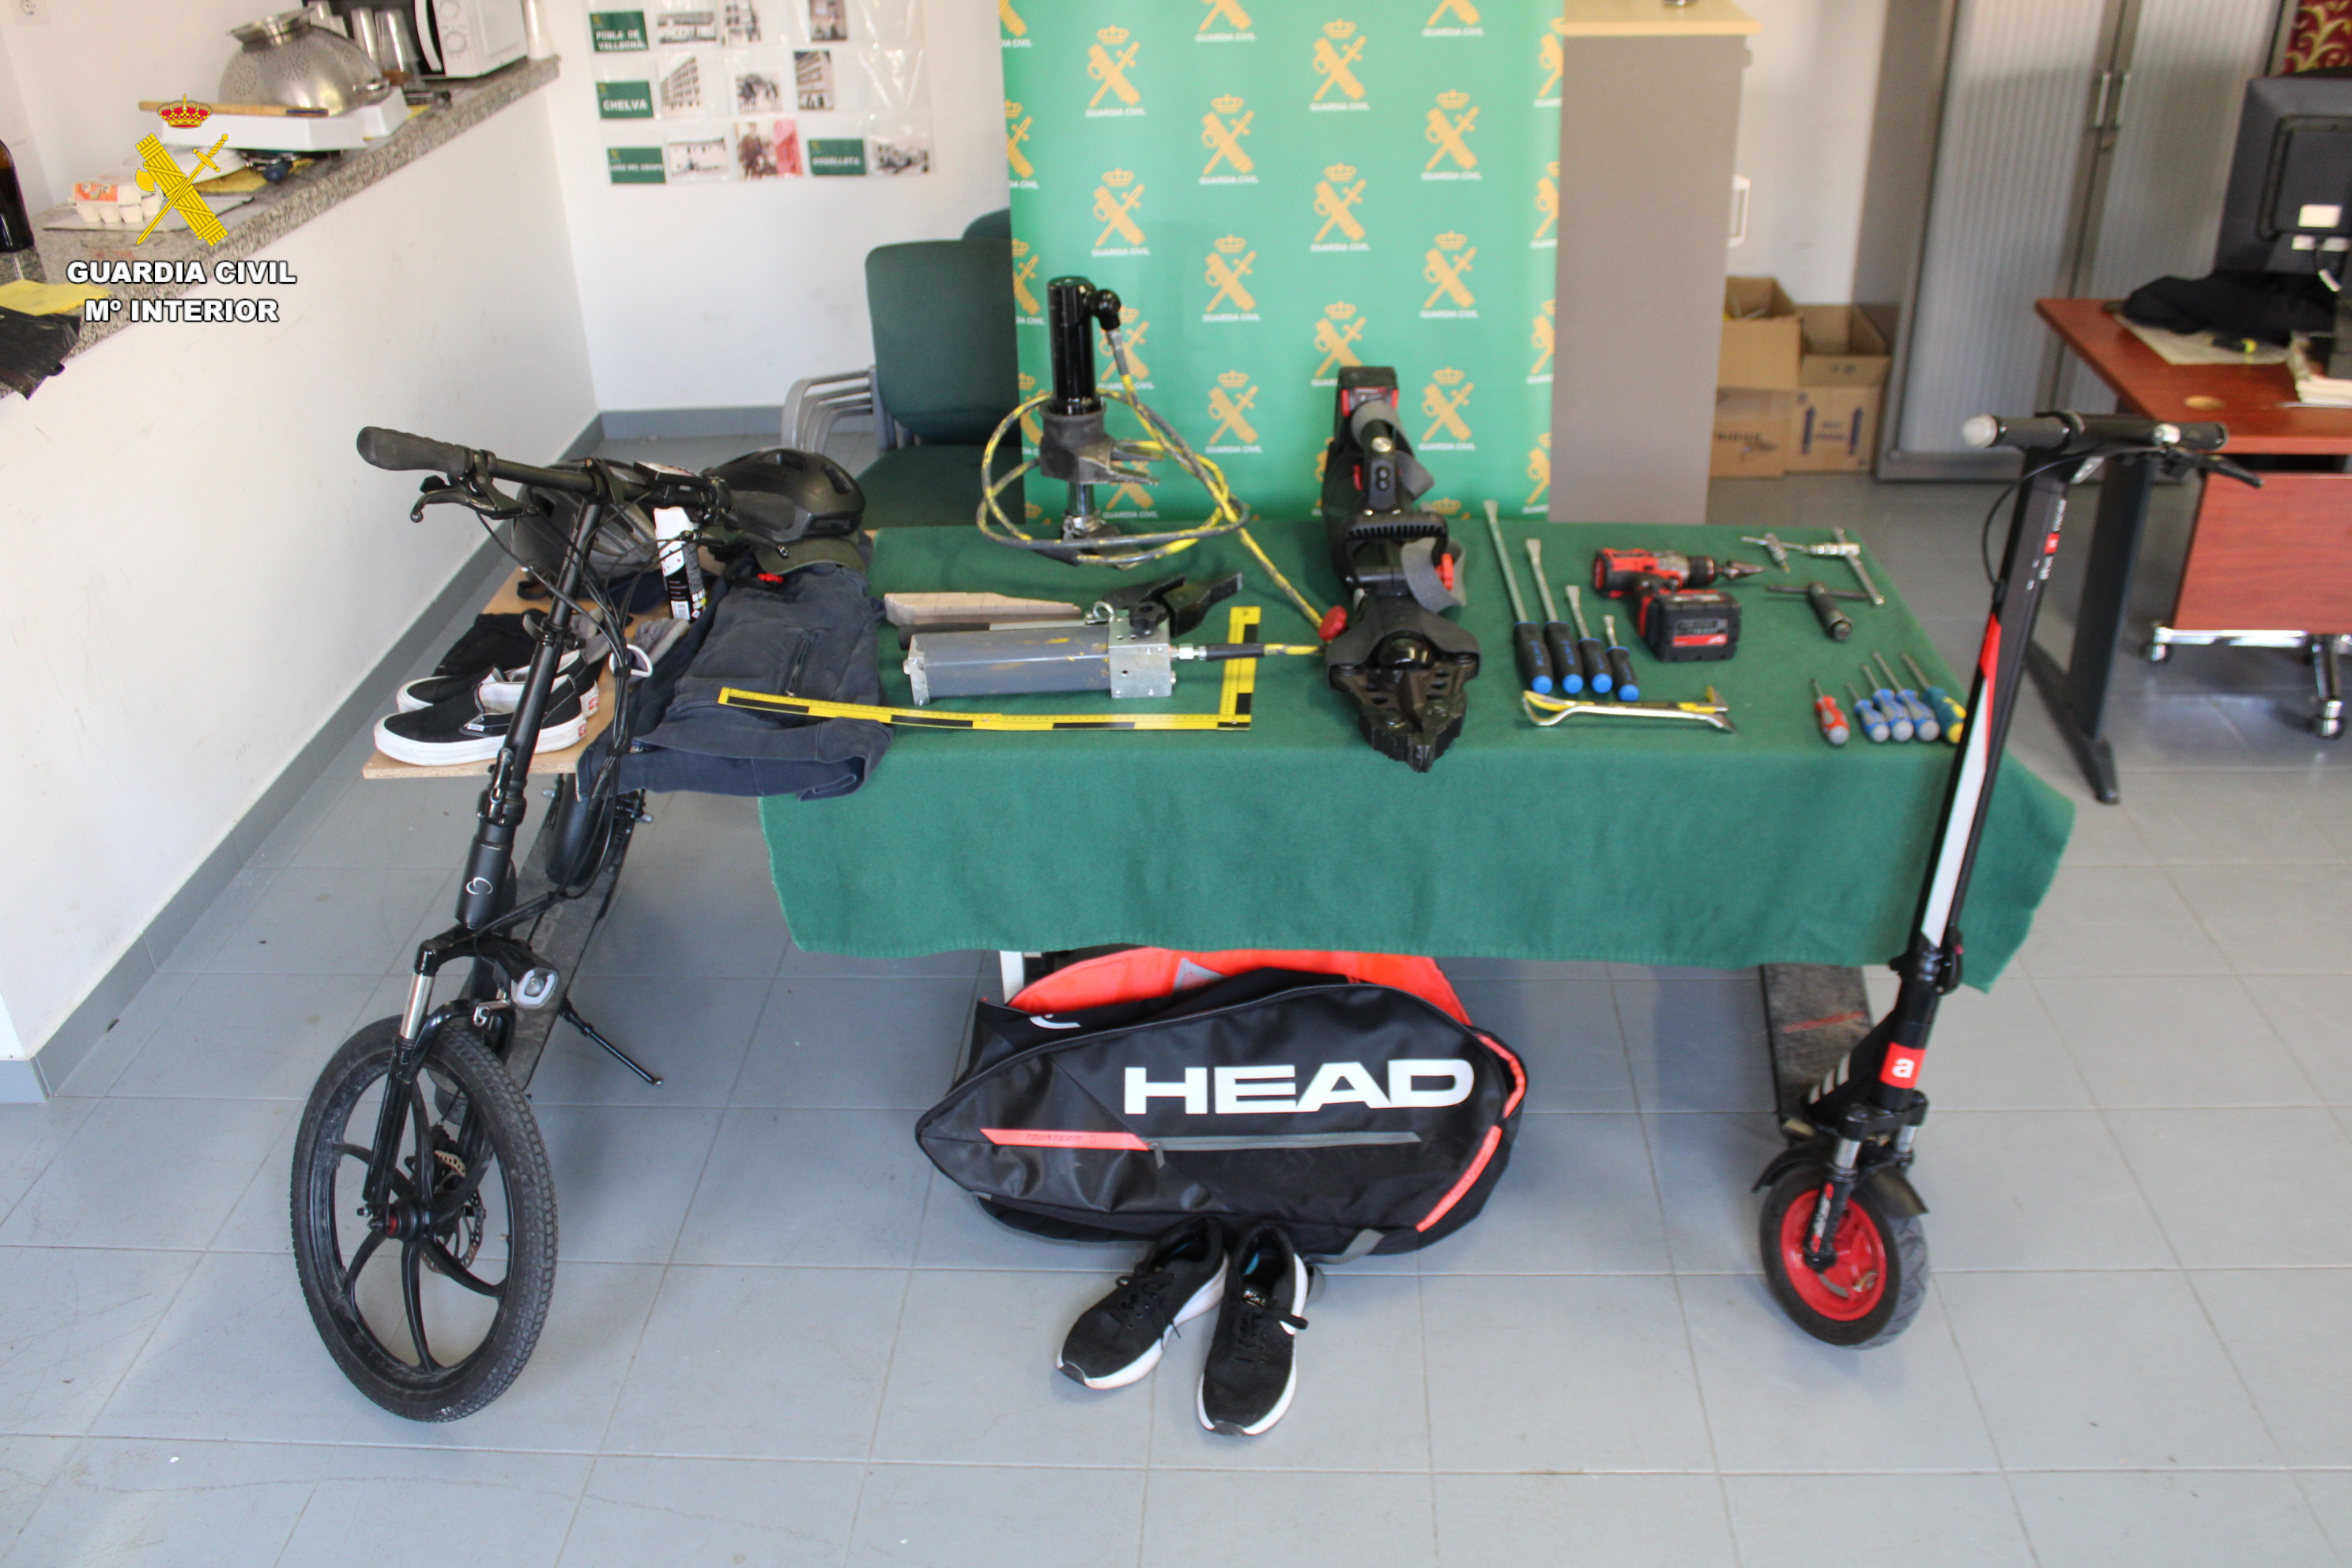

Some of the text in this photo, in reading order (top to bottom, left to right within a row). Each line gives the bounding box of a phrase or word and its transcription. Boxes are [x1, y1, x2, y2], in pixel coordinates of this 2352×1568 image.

[603, 99, 649, 111] CHELVA
[1891, 1057, 1914, 1078] a
[1125, 1058, 1475, 1115] HEAD
